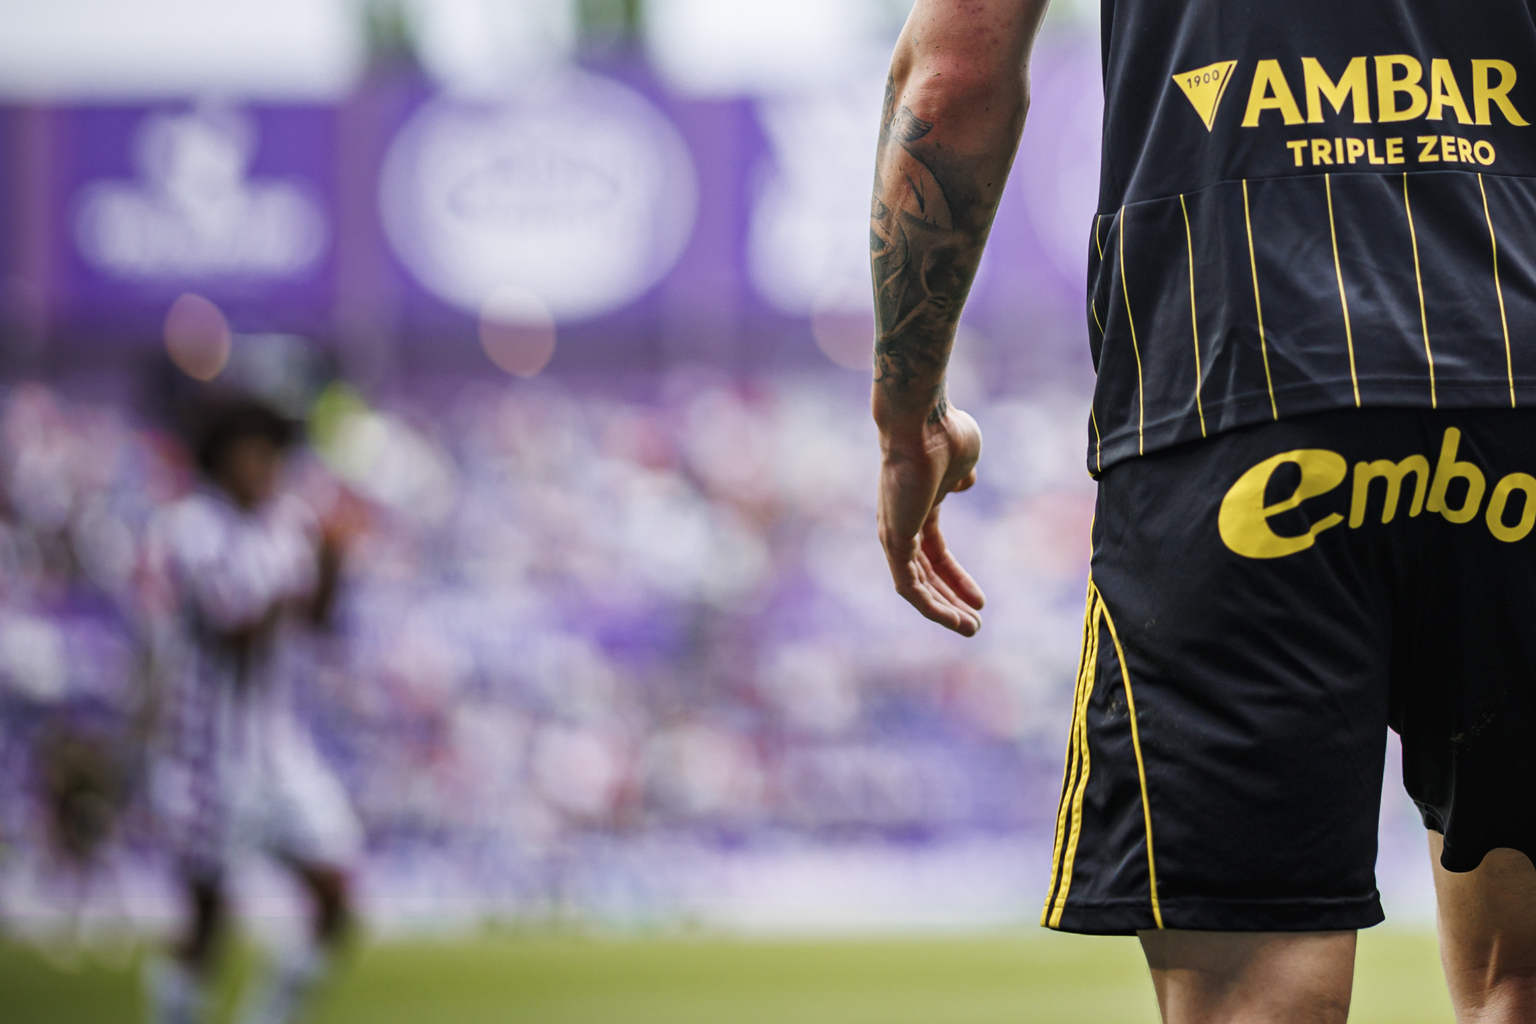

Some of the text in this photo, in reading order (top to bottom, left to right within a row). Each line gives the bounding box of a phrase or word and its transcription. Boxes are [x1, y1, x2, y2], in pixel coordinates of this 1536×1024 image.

[1187, 69, 1220, 89] 1900
[1241, 54, 1532, 128] AMBAR
[1287, 135, 1497, 167] TRIPLE ZERO
